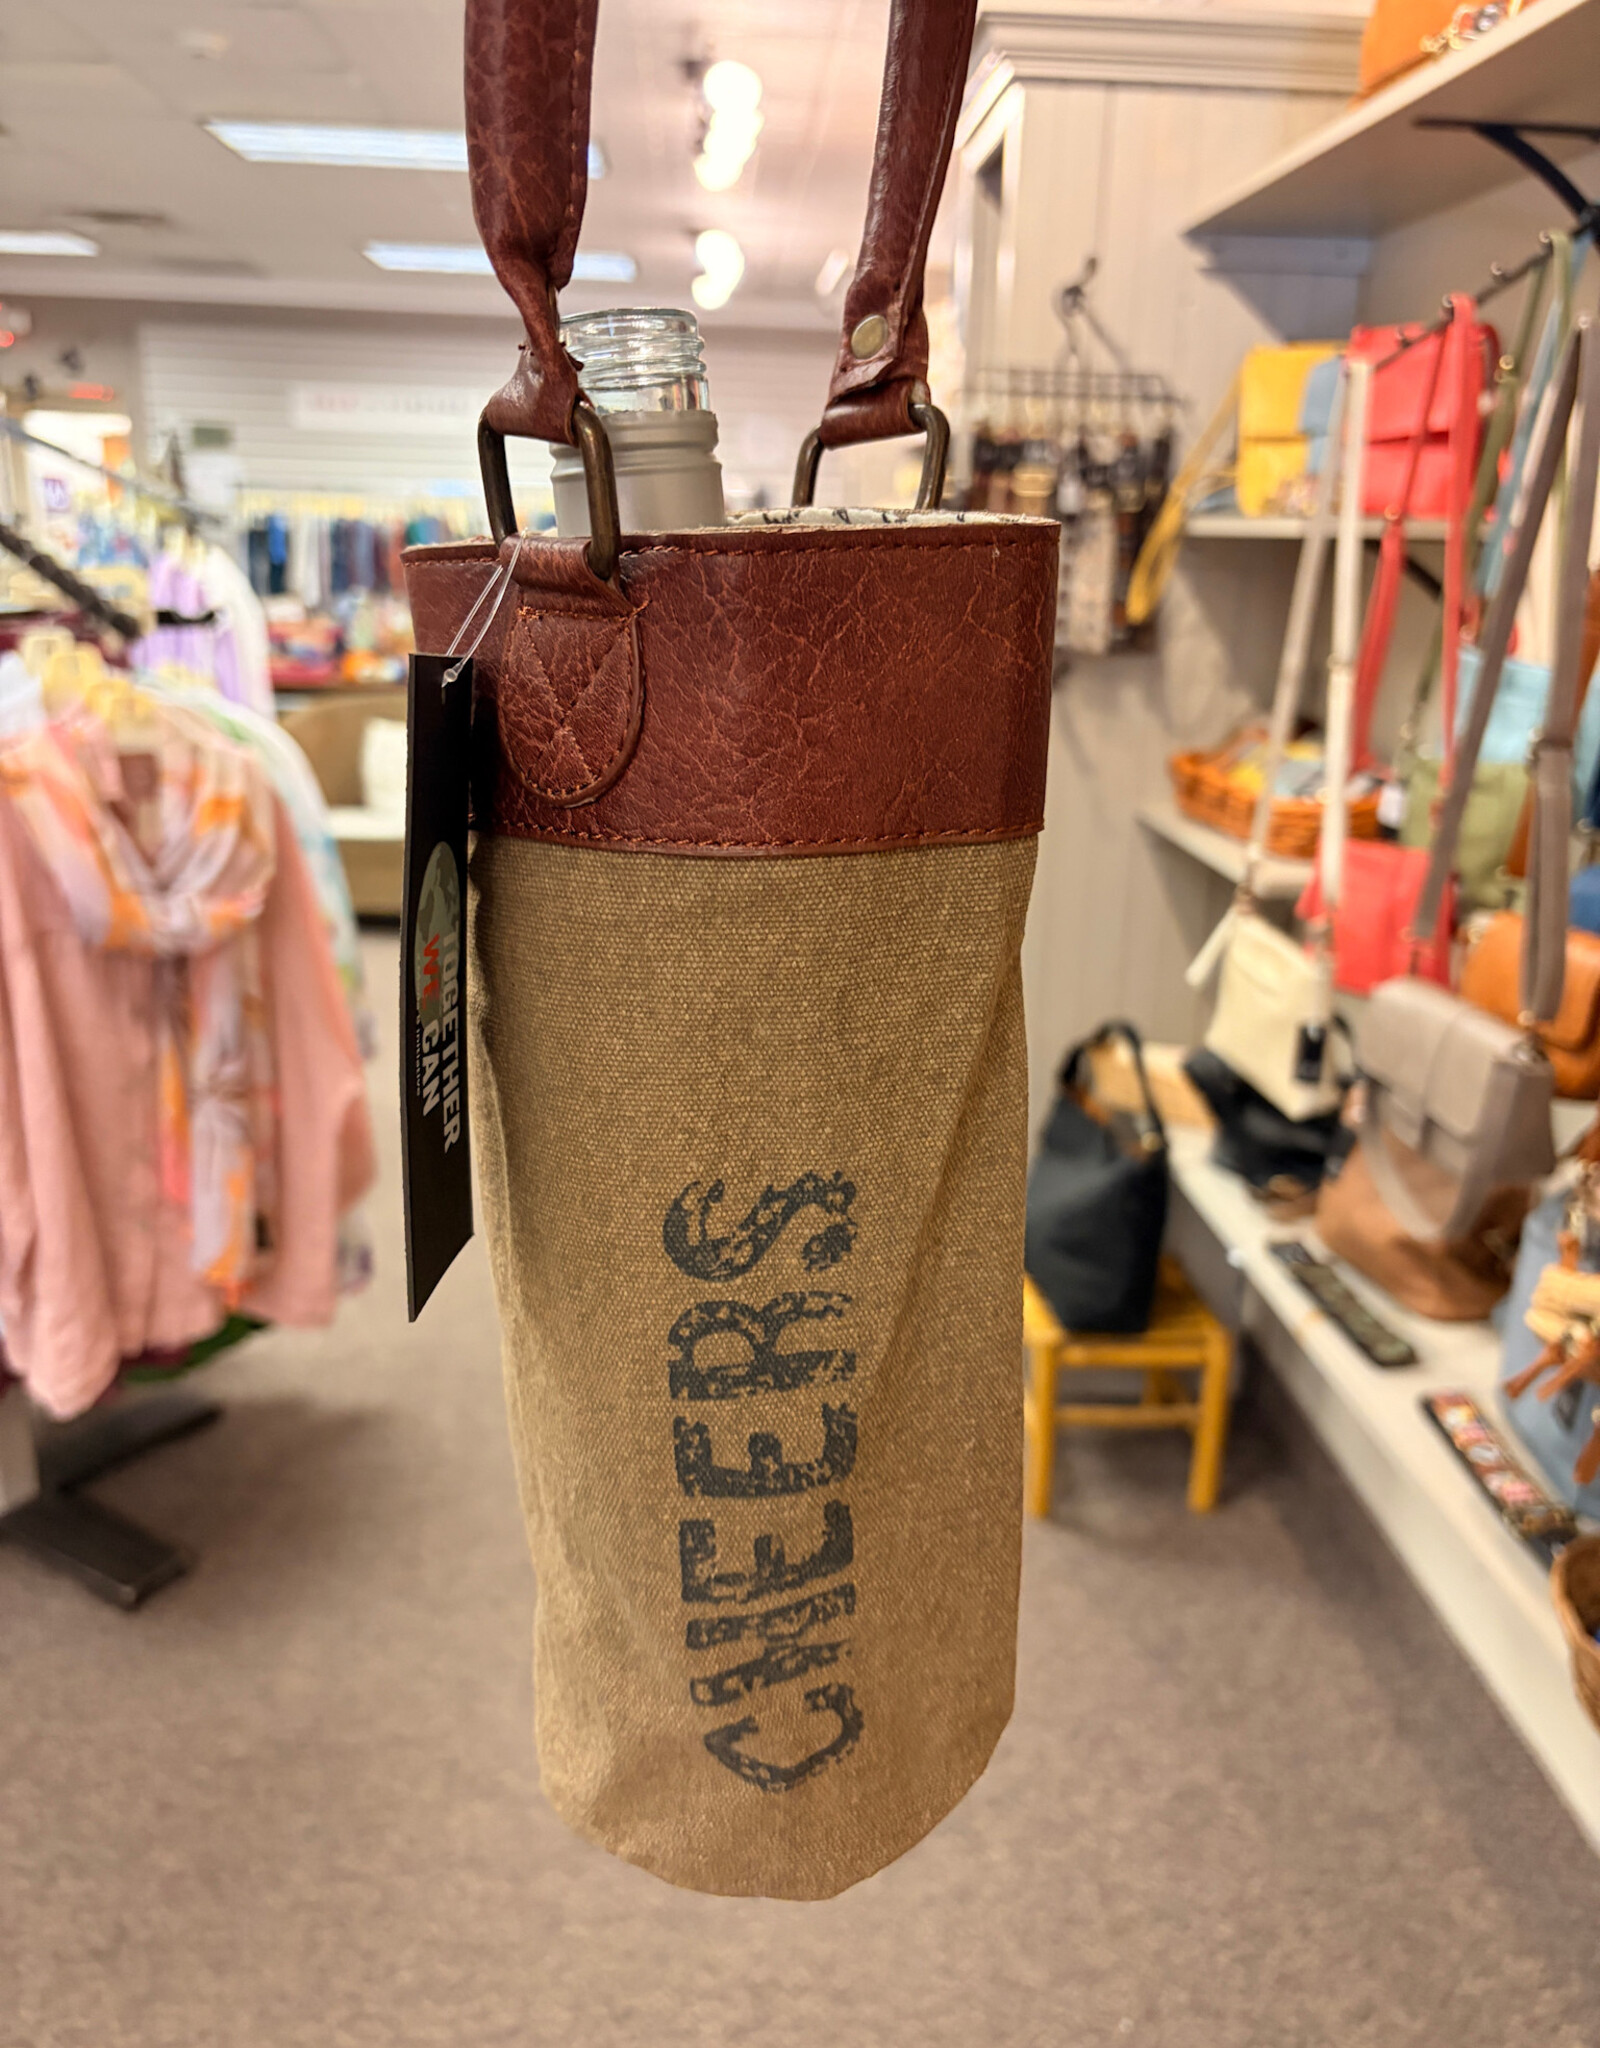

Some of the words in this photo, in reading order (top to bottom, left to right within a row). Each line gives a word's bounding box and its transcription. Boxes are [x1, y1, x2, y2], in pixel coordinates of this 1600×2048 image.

[422, 932, 440, 1011] WE
[443, 922, 460, 1153] TOGETHER
[422, 1019, 440, 1116] CAN
[662, 1169, 865, 1794] CHEERS
